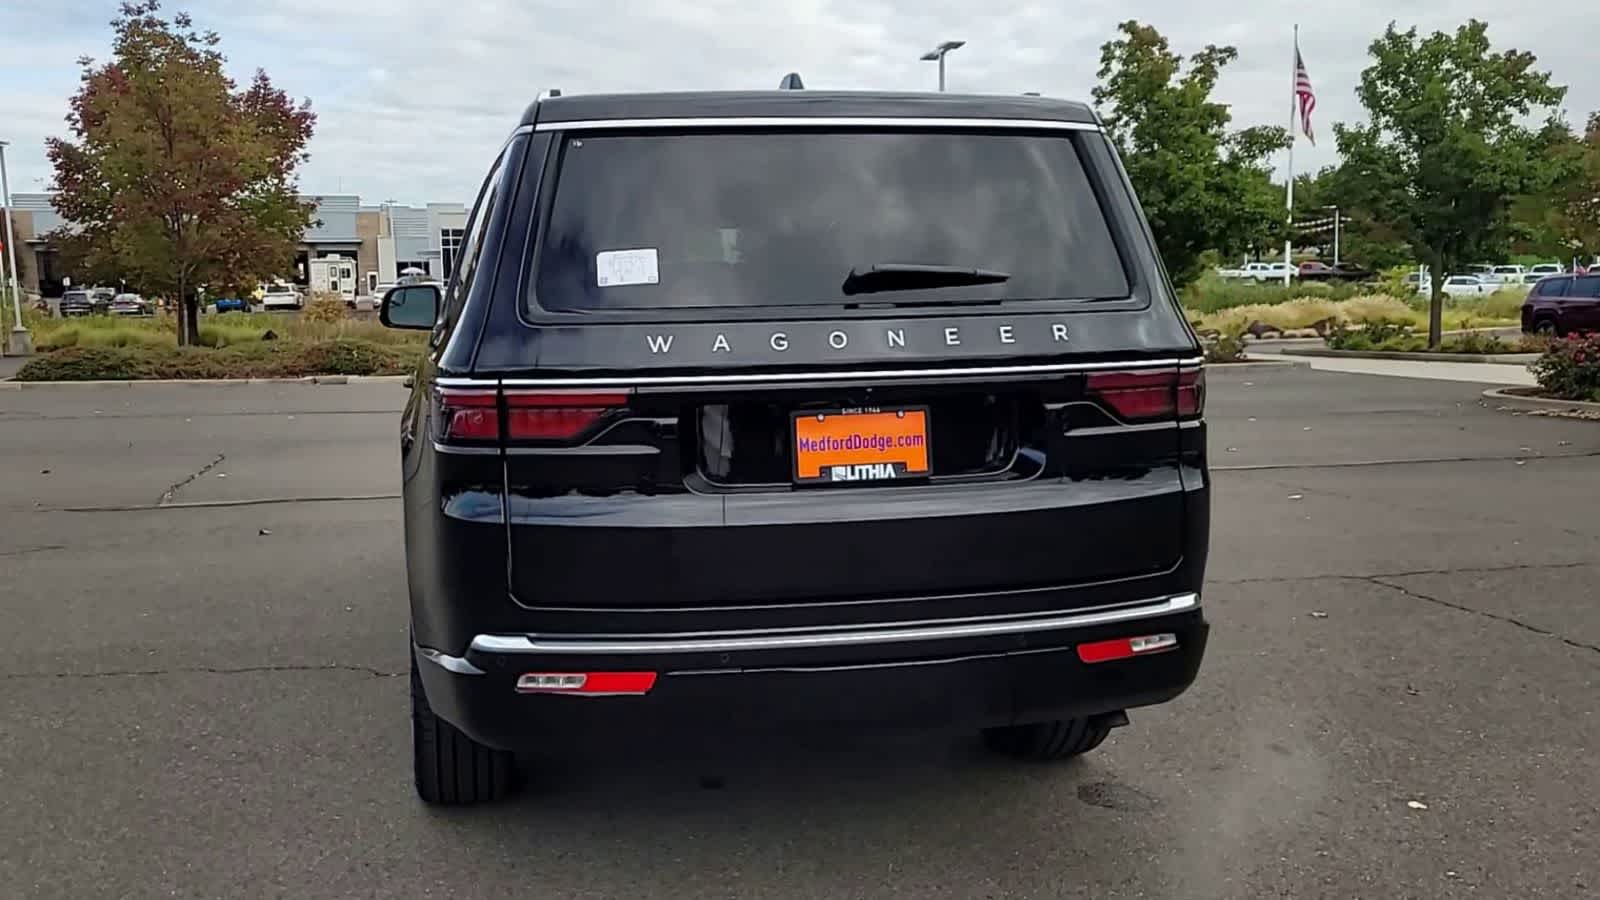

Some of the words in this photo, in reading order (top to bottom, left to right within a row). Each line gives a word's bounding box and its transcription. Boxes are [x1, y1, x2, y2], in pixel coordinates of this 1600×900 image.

[647, 323, 1070, 353] WAGONEER
[799, 433, 924, 453] MedfordDodge.com
[847, 463, 896, 480] LITHIA
